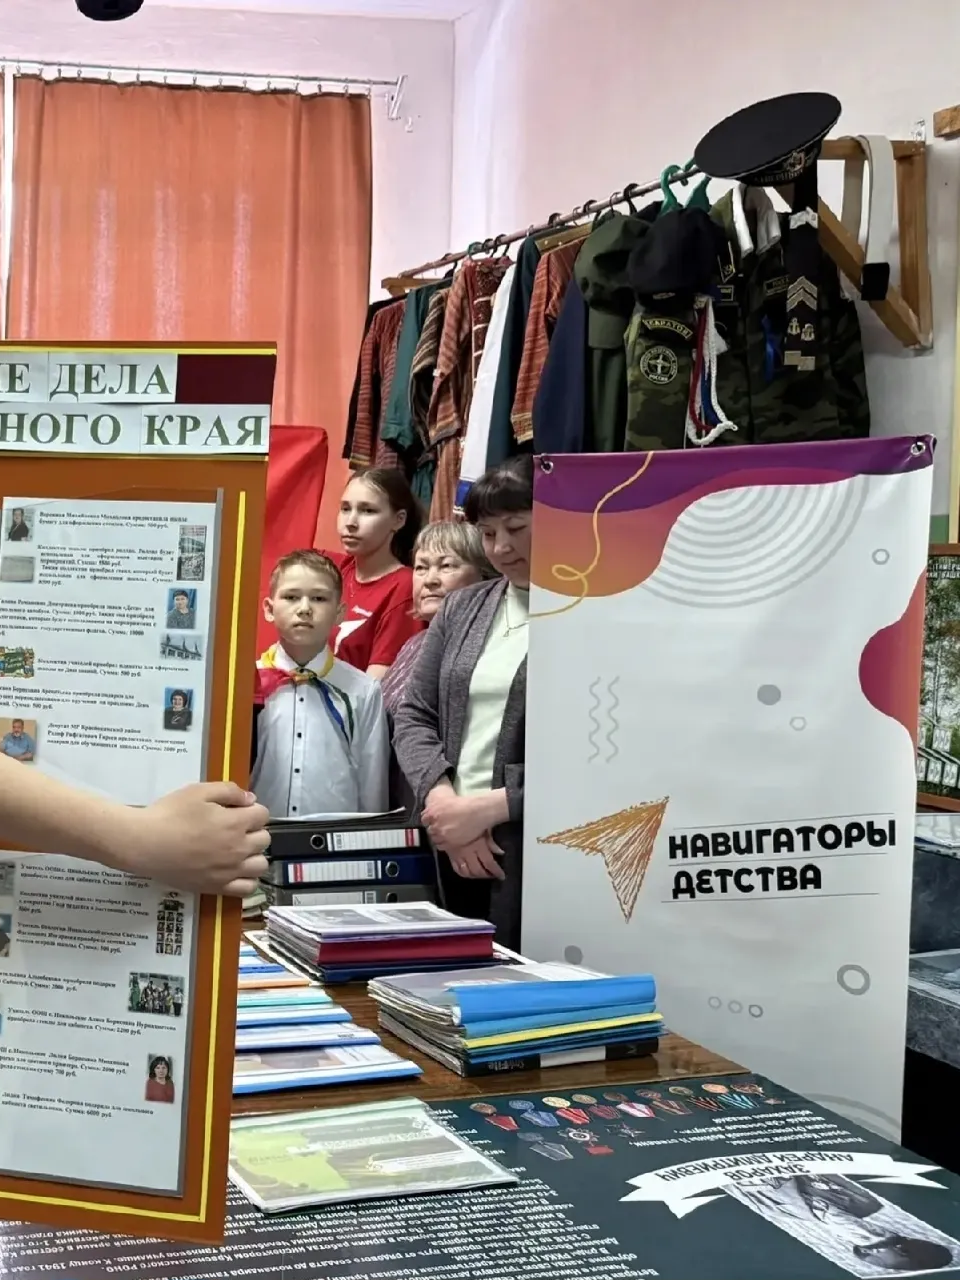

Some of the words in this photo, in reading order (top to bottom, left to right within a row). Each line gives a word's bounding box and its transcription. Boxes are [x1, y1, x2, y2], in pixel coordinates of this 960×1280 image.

[49, 363, 172, 402] ДЕЛА
[143, 414, 267, 446] КРАЯ
[669, 820, 896, 859] НАВИГАТОРЫ
[672, 863, 822, 899] ДЕТСТВА
[778, 1151, 855, 1164] АНДРЕЙ
[654, 1152, 774, 1182] ДМИТРИЕВИЧ
[724, 1163, 810, 1181] ЗАХАРОВ
[112, 1252, 164, 1262] училище.
[234, 1244, 305, 1259] инспектором
[36, 1262, 66, 1271] 1941
[68, 1257, 101, 1267] концу
[100, 1264, 138, 1273] РОНО.
